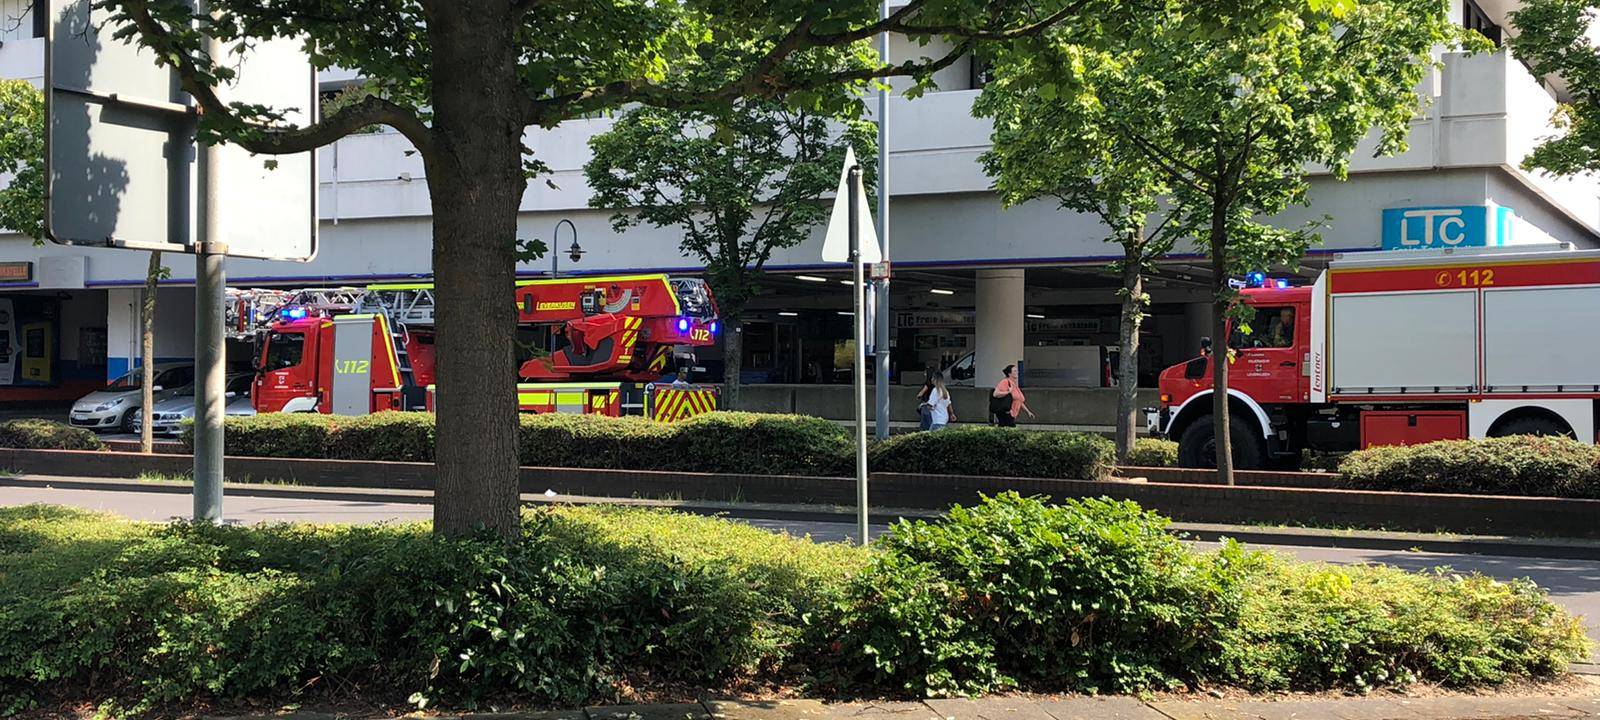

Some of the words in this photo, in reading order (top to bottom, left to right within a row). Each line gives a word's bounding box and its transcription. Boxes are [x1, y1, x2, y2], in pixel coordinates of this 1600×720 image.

[1401, 209, 1465, 245] LTC
[1457, 269, 1494, 286] 112
[897, 313, 914, 326] LTC
[694, 328, 710, 341] 112
[343, 360, 369, 374] 112
